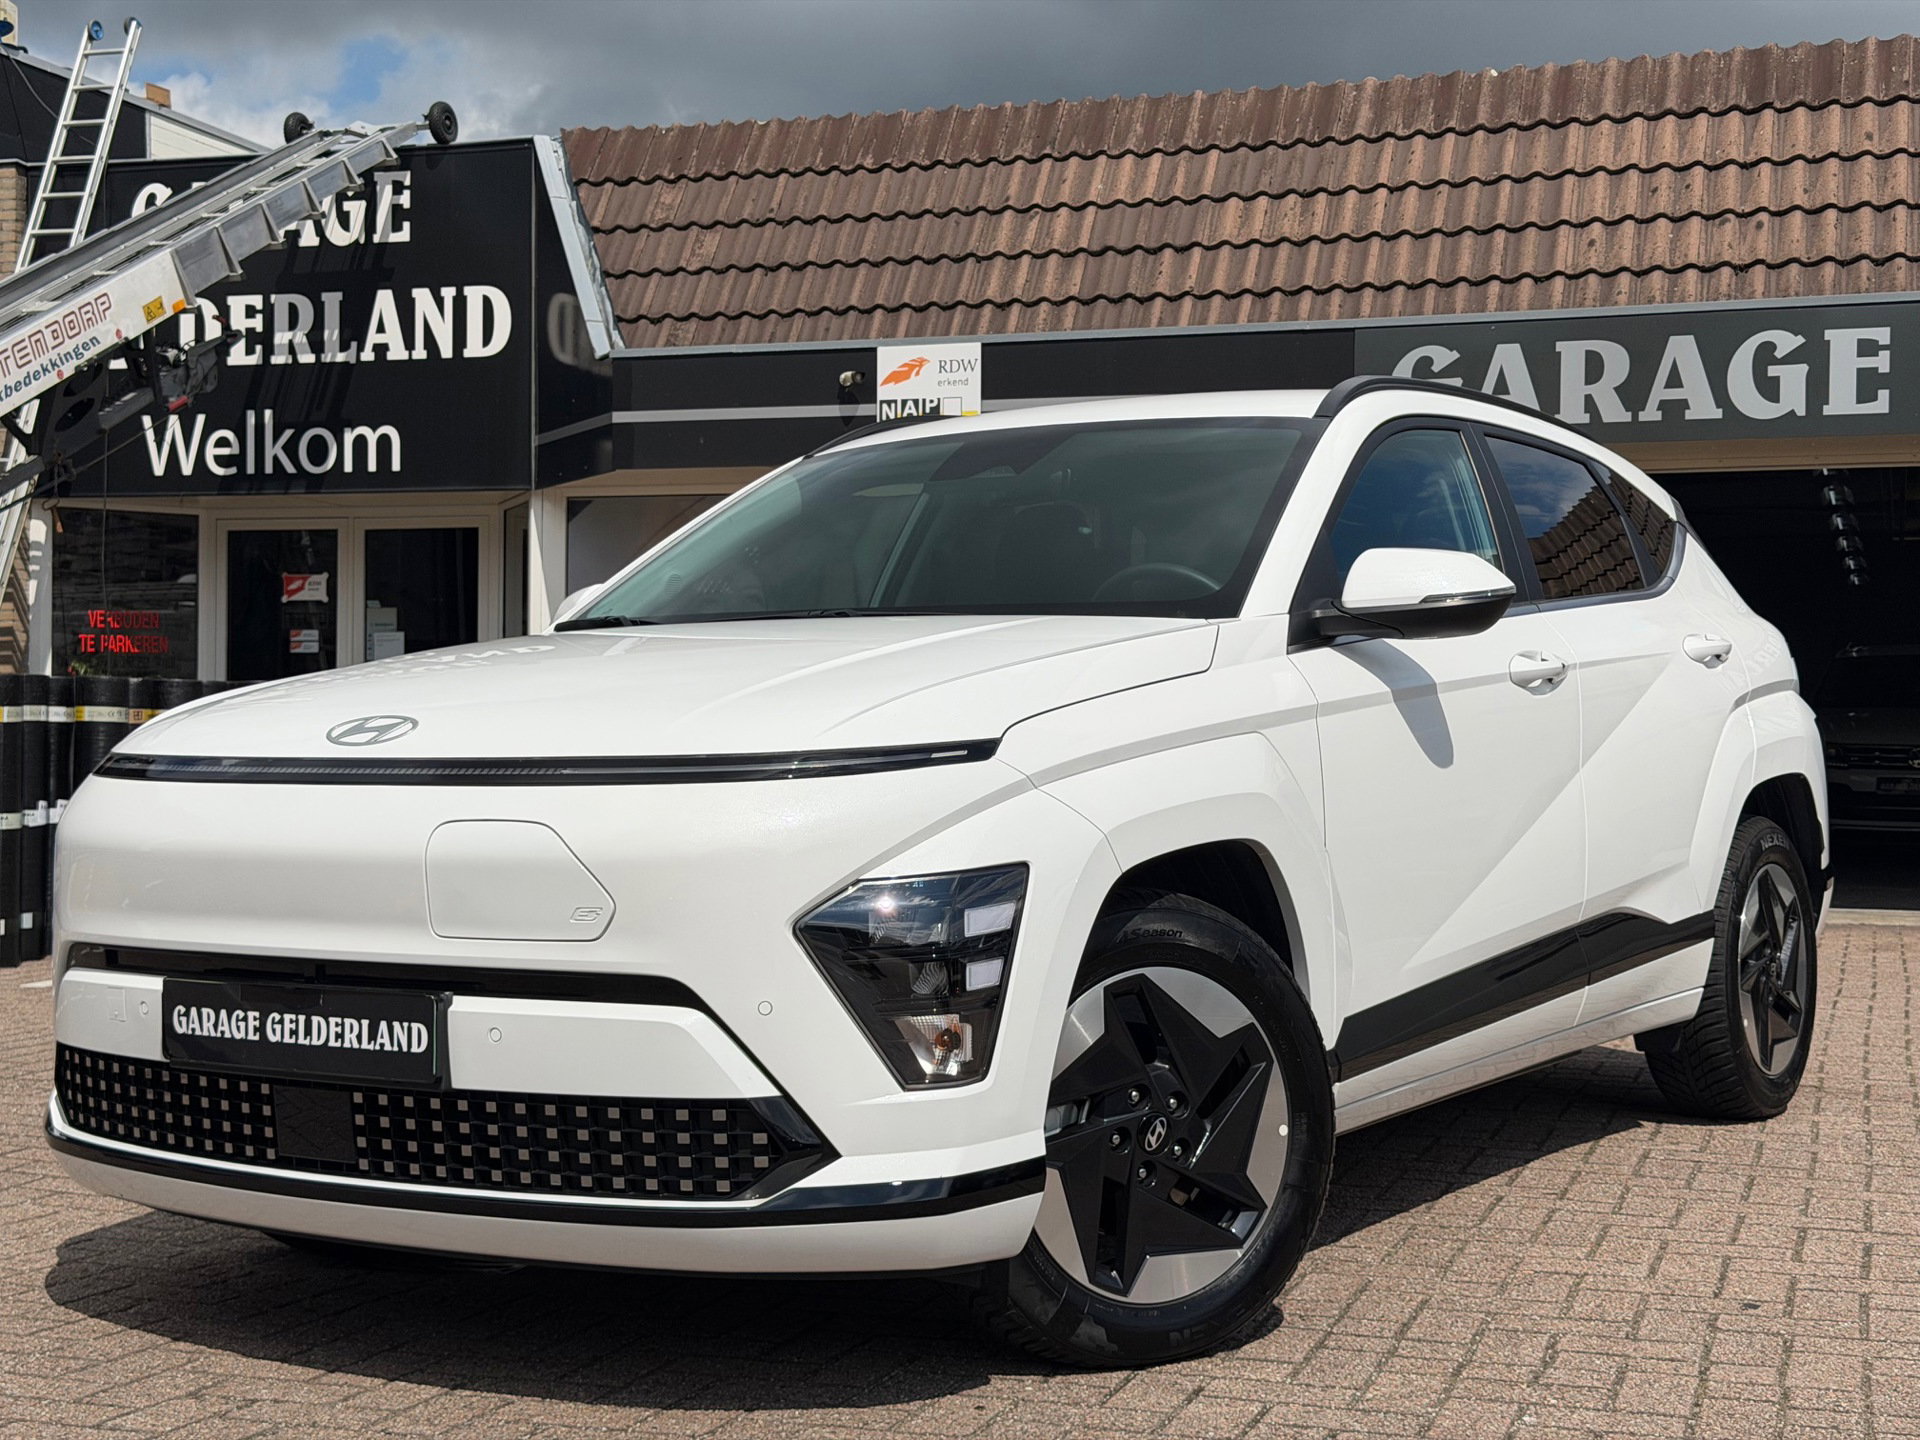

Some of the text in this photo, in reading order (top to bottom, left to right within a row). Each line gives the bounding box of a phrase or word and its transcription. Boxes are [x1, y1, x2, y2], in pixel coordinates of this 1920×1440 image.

[108, 284, 512, 370] DERLAND
[938, 358, 978, 374] RDW
[937, 377, 969, 387] erkend
[881, 398, 939, 421] NAP
[141, 408, 402, 477] Welkom
[79, 634, 169, 654] TE PARKEREN
[172, 1004, 429, 1053] GARAGE GELDERLAND
